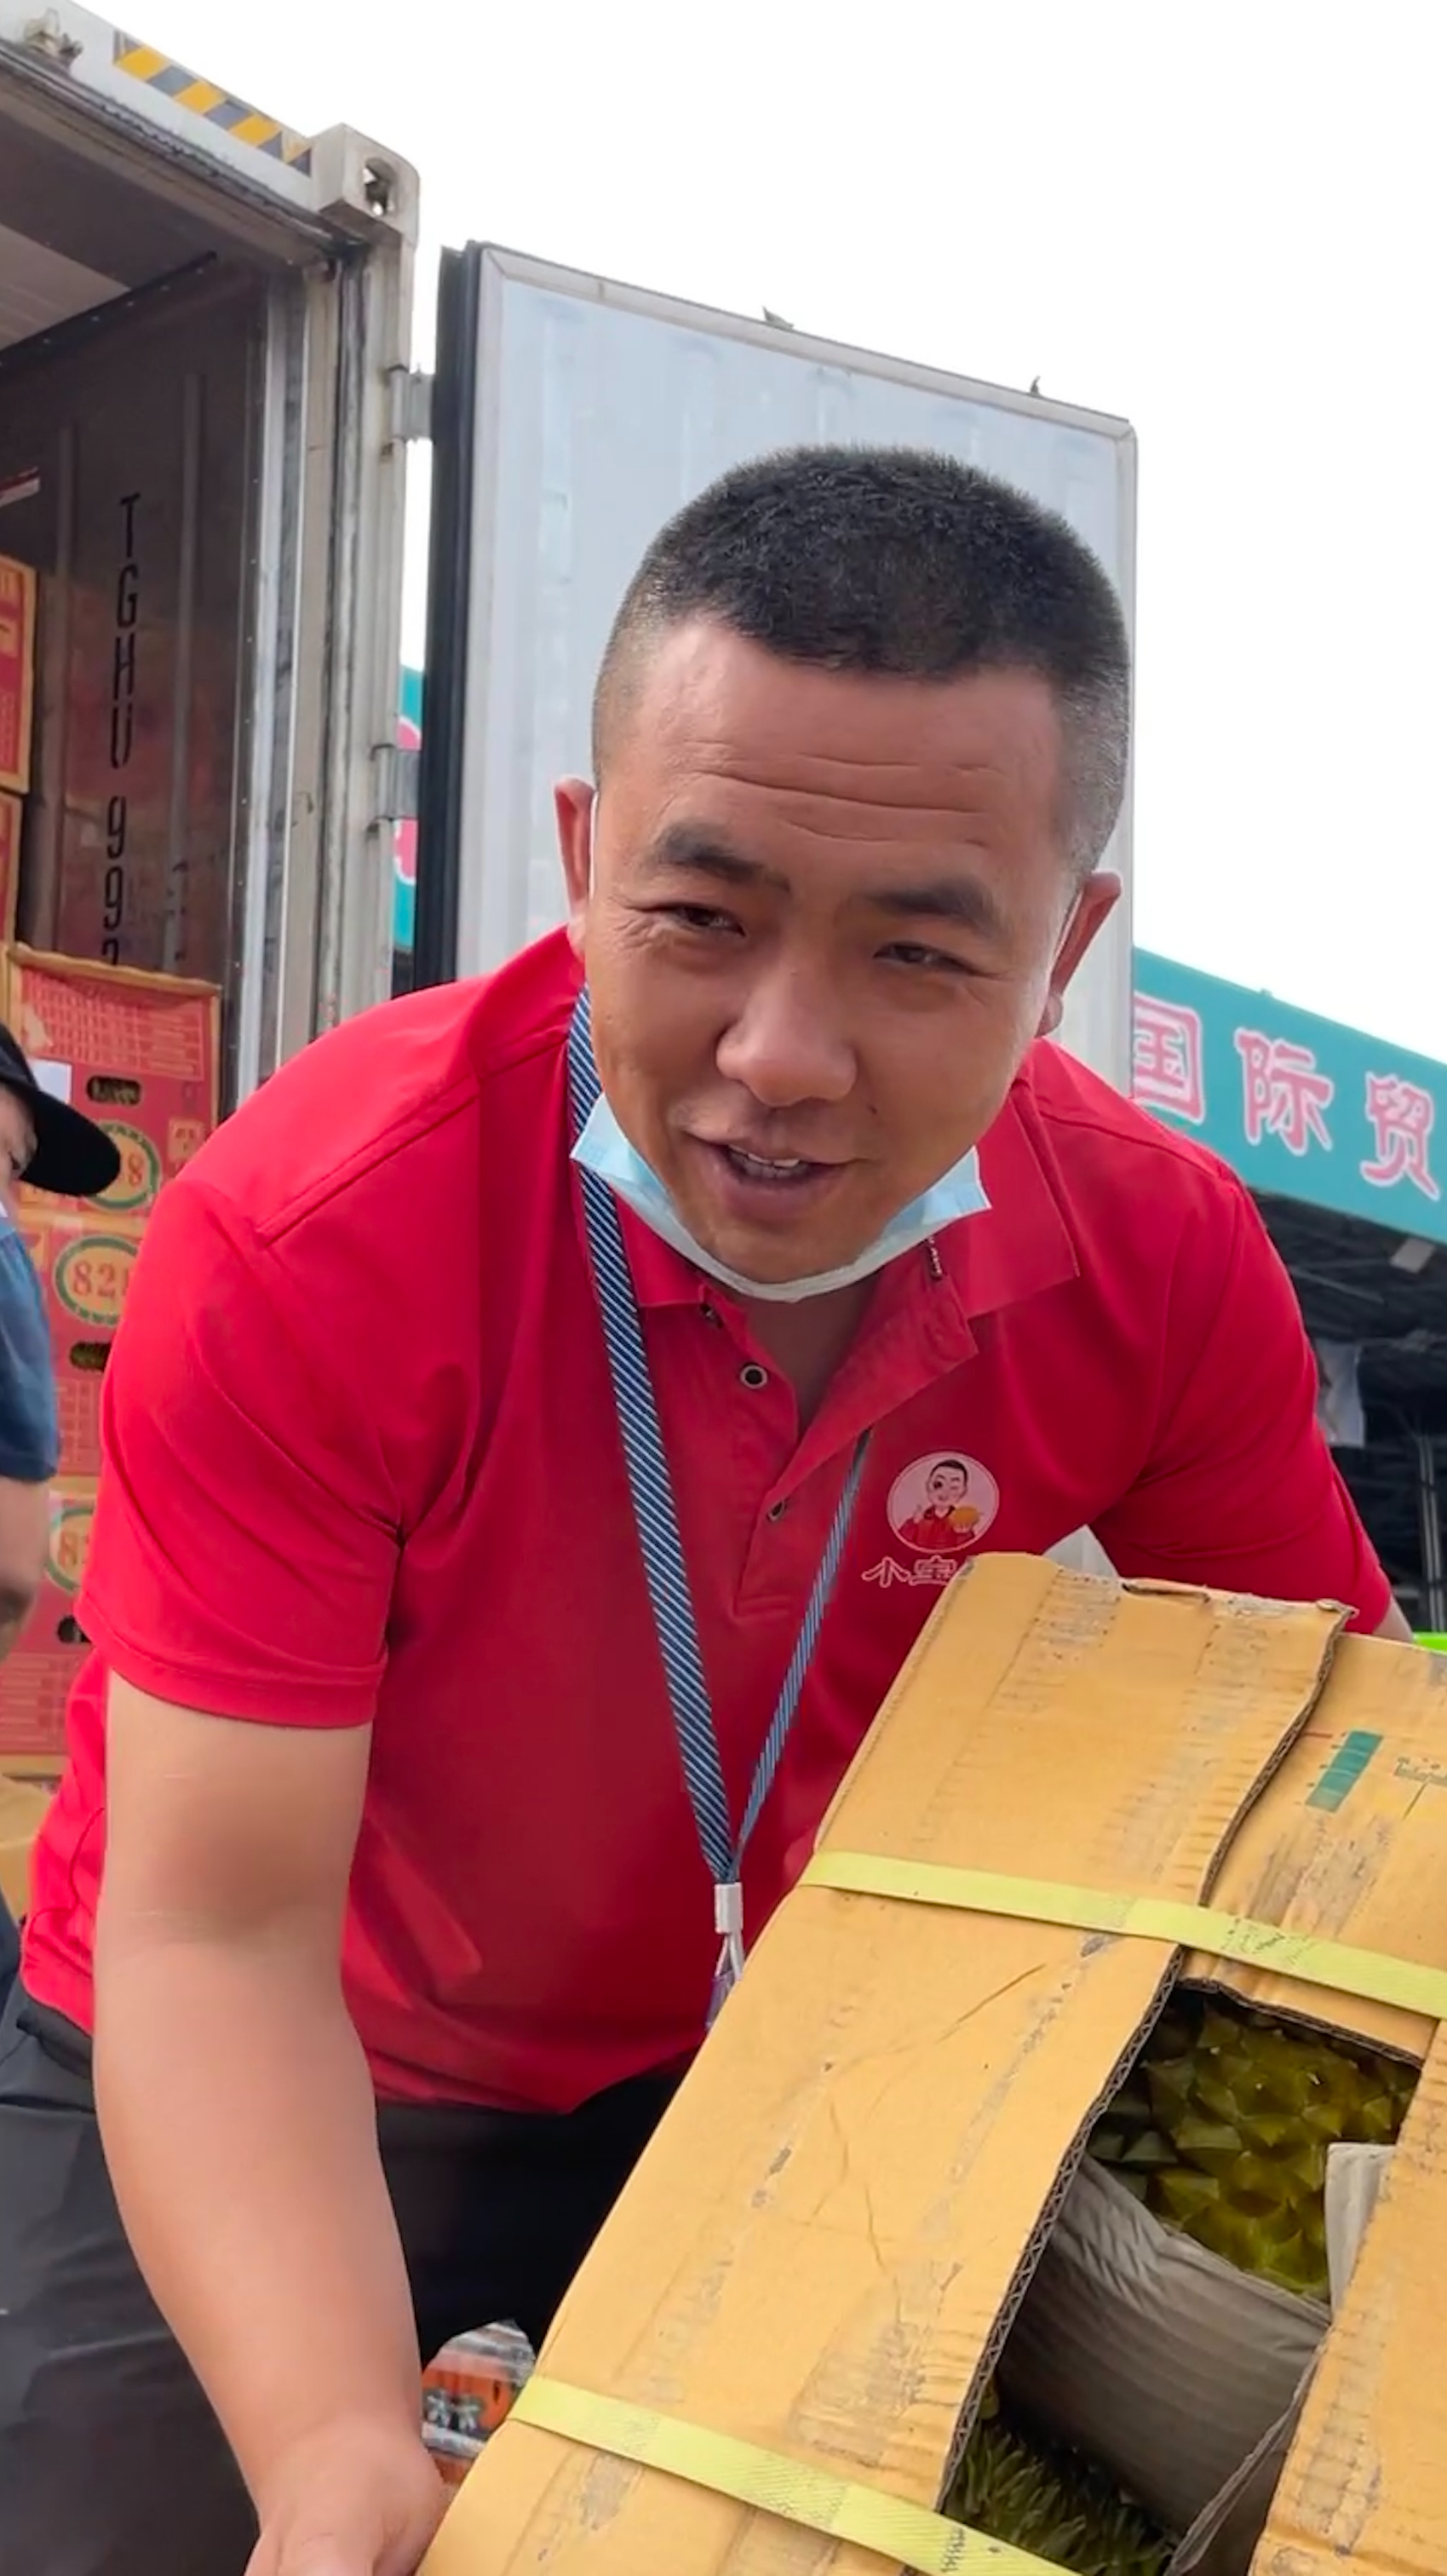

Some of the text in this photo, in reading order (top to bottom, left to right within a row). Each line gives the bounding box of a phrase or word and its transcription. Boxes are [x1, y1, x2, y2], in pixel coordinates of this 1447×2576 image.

[109, 492, 141, 769] TGHU
[1134, 991, 1441, 1202] 国际贸
